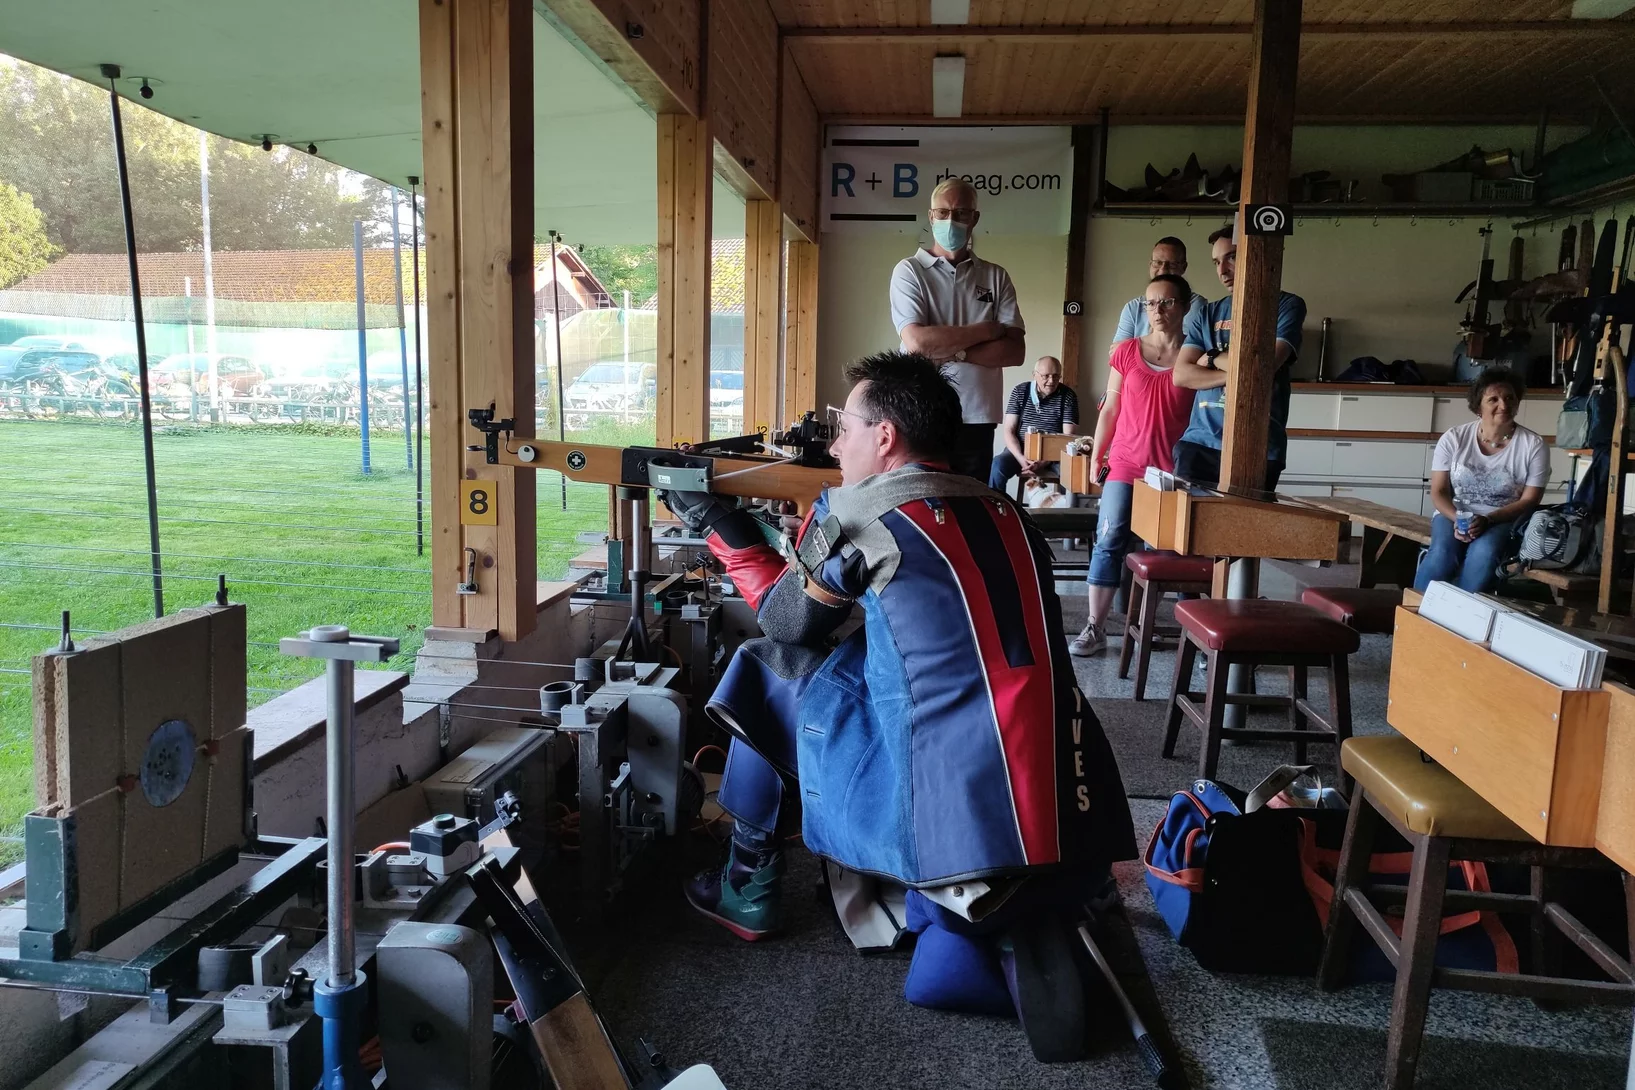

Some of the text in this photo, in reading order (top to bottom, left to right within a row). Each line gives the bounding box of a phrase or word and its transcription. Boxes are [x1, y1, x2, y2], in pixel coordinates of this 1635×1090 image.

[832, 163, 855, 197] R
[893, 163, 919, 197] B
[757, 425, 768, 436] 12
[470, 489, 488, 515] 8
[1072, 687, 1090, 812] YVES
